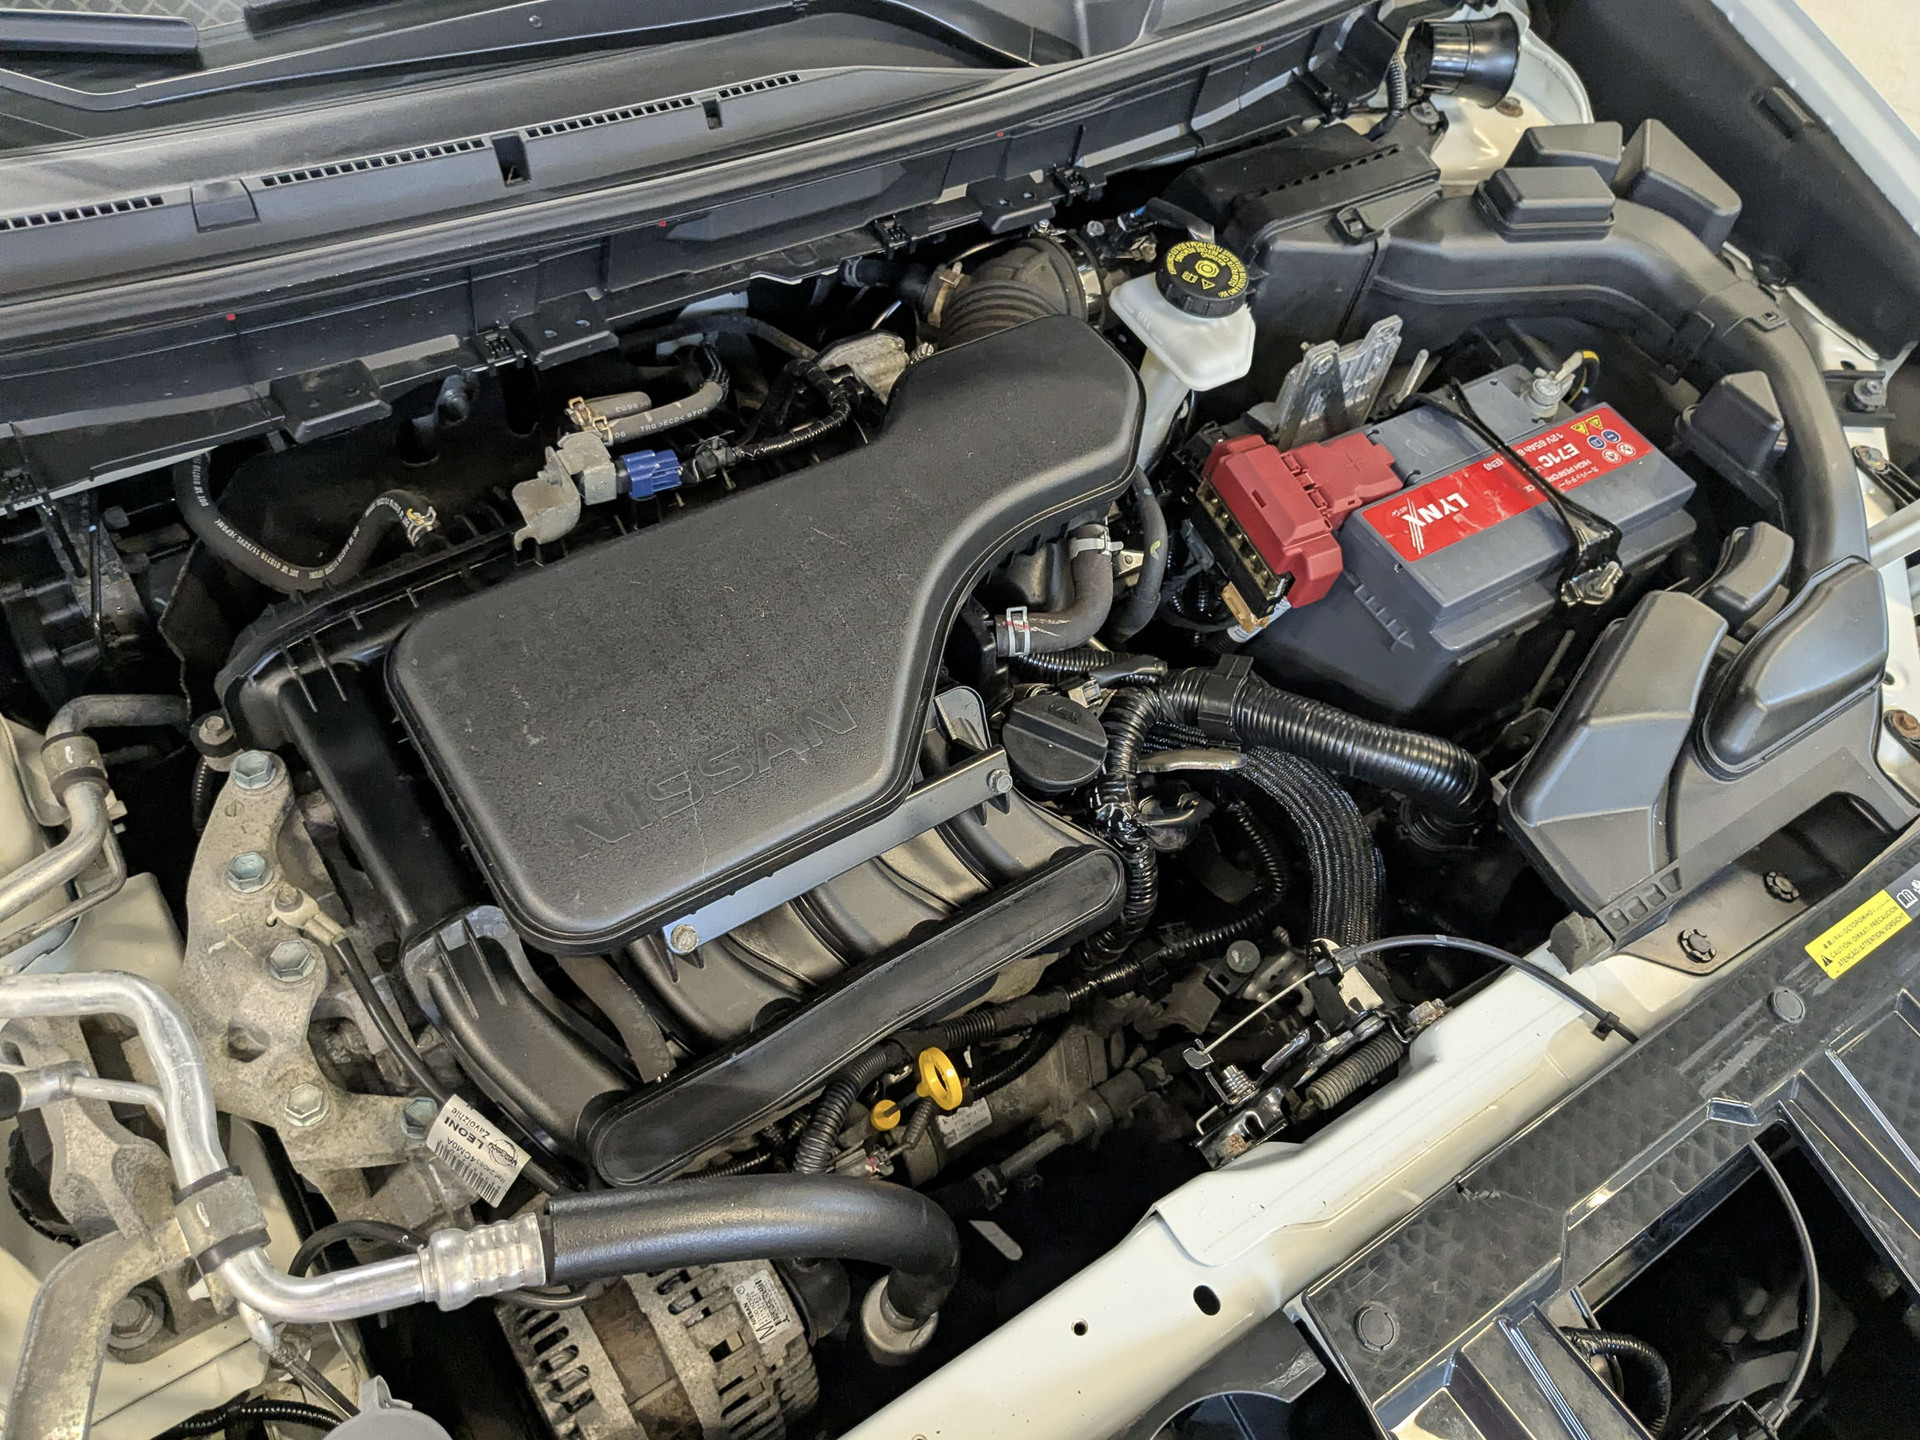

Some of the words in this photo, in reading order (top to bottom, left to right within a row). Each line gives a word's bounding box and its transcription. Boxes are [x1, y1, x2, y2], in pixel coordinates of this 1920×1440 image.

[1523, 439, 1546, 453] 65Ah
[1545, 432, 1563, 443] 12V
[1537, 442, 1579, 468] E71C
[1573, 458, 1591, 470] HIGH
[1401, 492, 1469, 534] LYNX
[562, 694, 857, 858] NISSAN
[443, 1116, 484, 1149] LEONI
